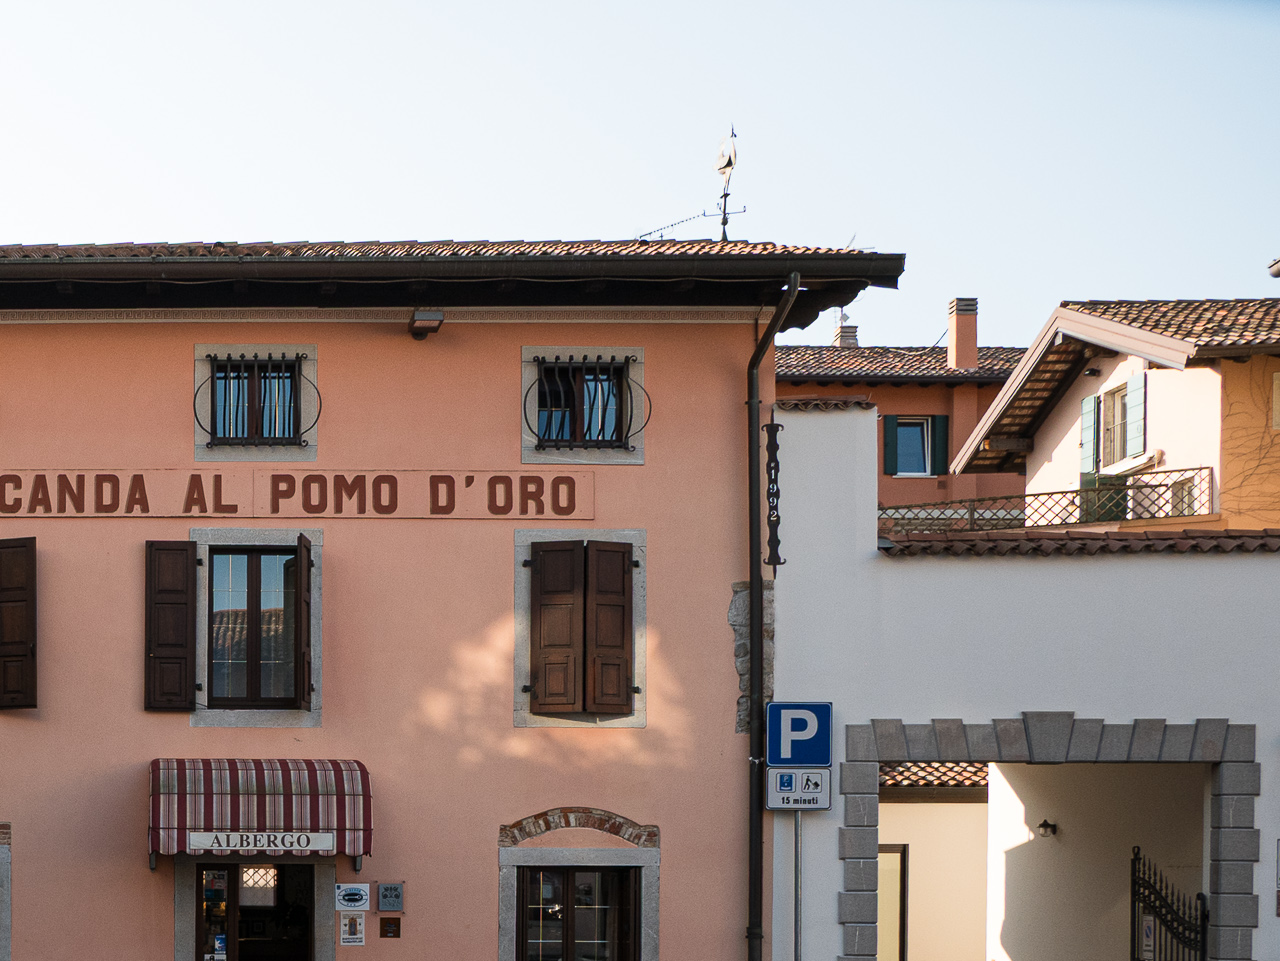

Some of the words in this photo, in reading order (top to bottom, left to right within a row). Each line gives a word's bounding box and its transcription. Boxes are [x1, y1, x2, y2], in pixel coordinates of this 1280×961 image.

[182, 473, 239, 514] AL
[270, 473, 399, 515] POMO
[428, 474, 577, 516] D'ORO
[769, 469, 778, 521] 1992
[780, 709, 819, 759] P
[781, 796, 791, 805] 15
[792, 796, 819, 805] minuti
[209, 833, 311, 849] ALBERGO
